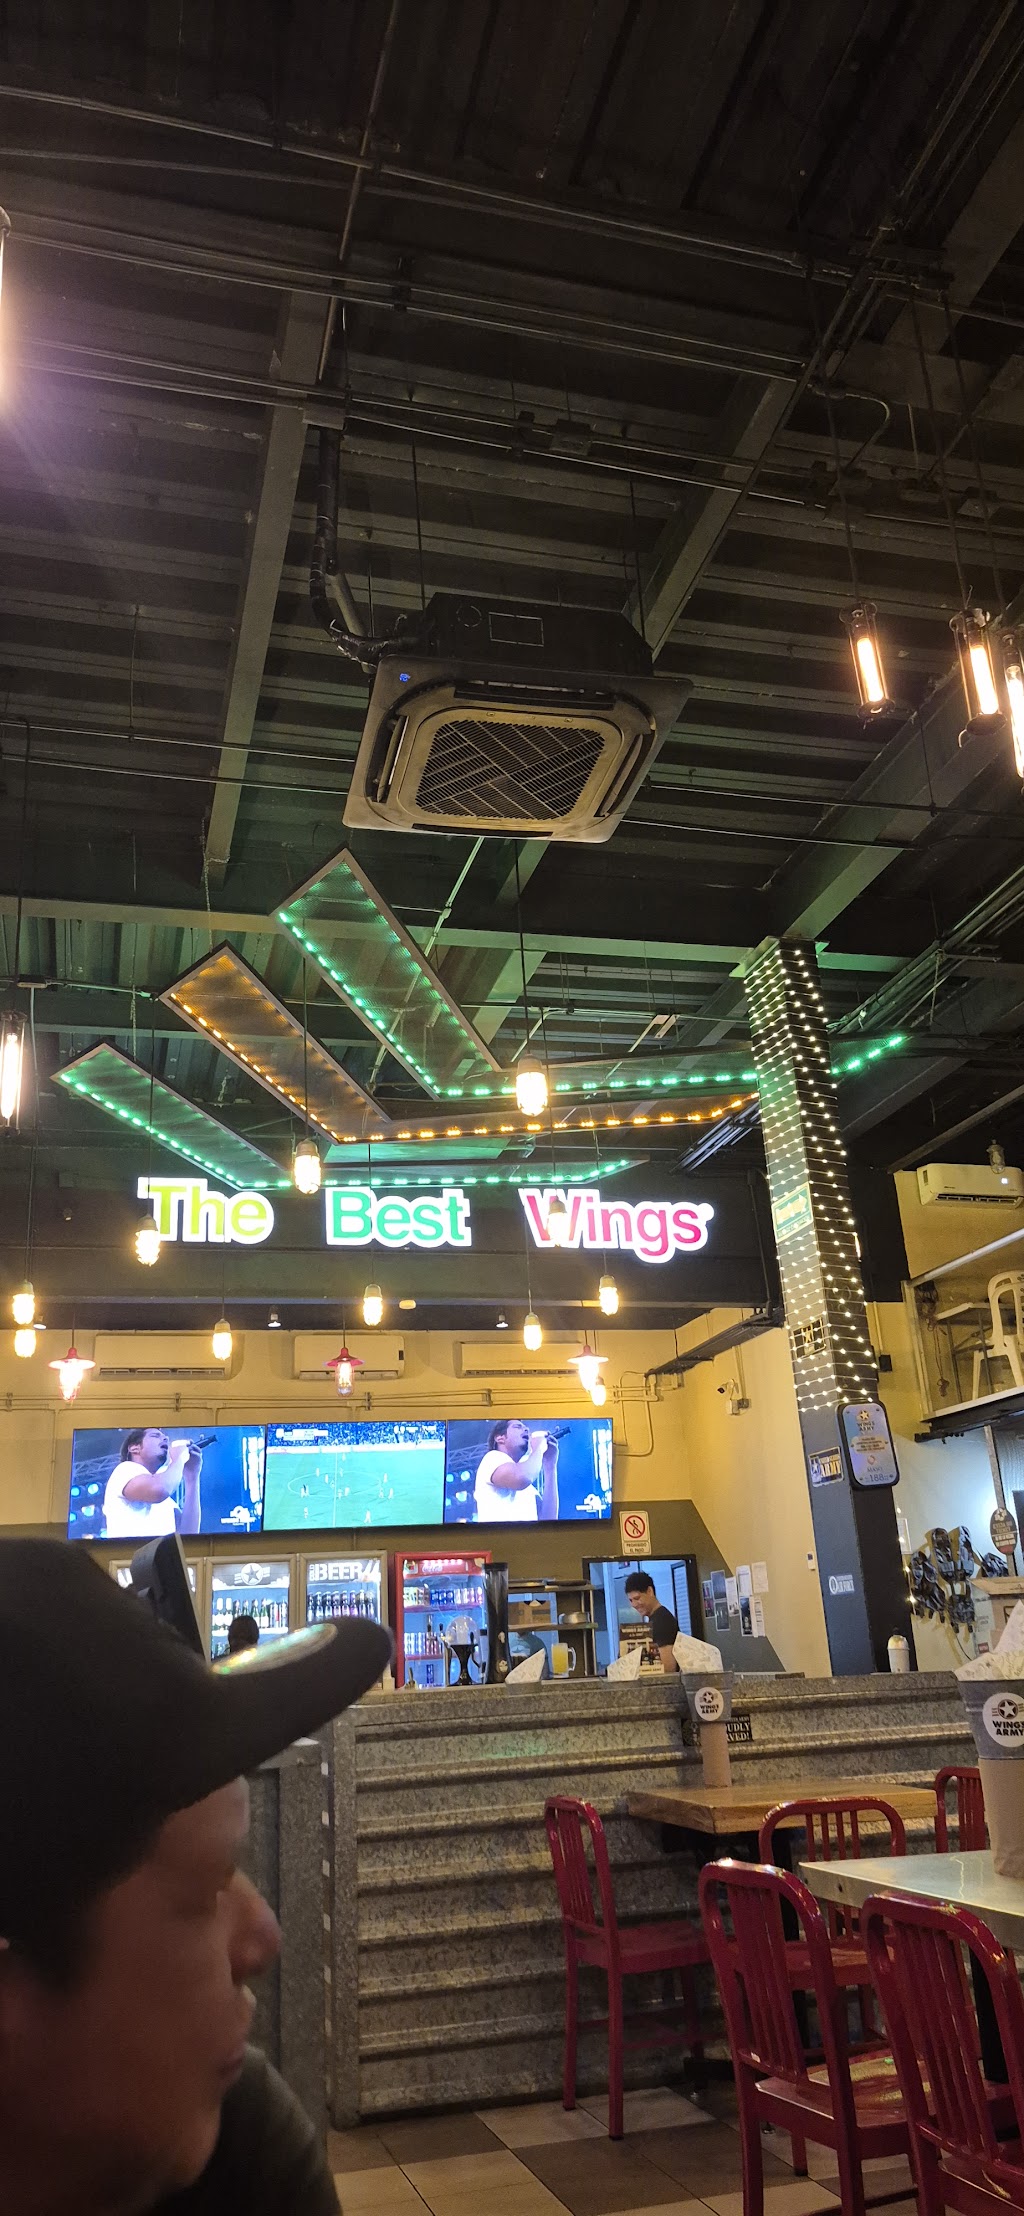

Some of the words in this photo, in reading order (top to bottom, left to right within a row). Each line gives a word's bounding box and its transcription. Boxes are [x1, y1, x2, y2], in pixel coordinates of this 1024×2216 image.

[140, 1178, 272, 1243] The
[327, 1188, 470, 1246] Best
[520, 1190, 706, 1261] Wings
[315, 1562, 362, 1580] BEER
[727, 1722, 750, 1732] UDLY
[992, 1720, 1024, 1729] WINGS
[728, 1732, 750, 1741] VED!
